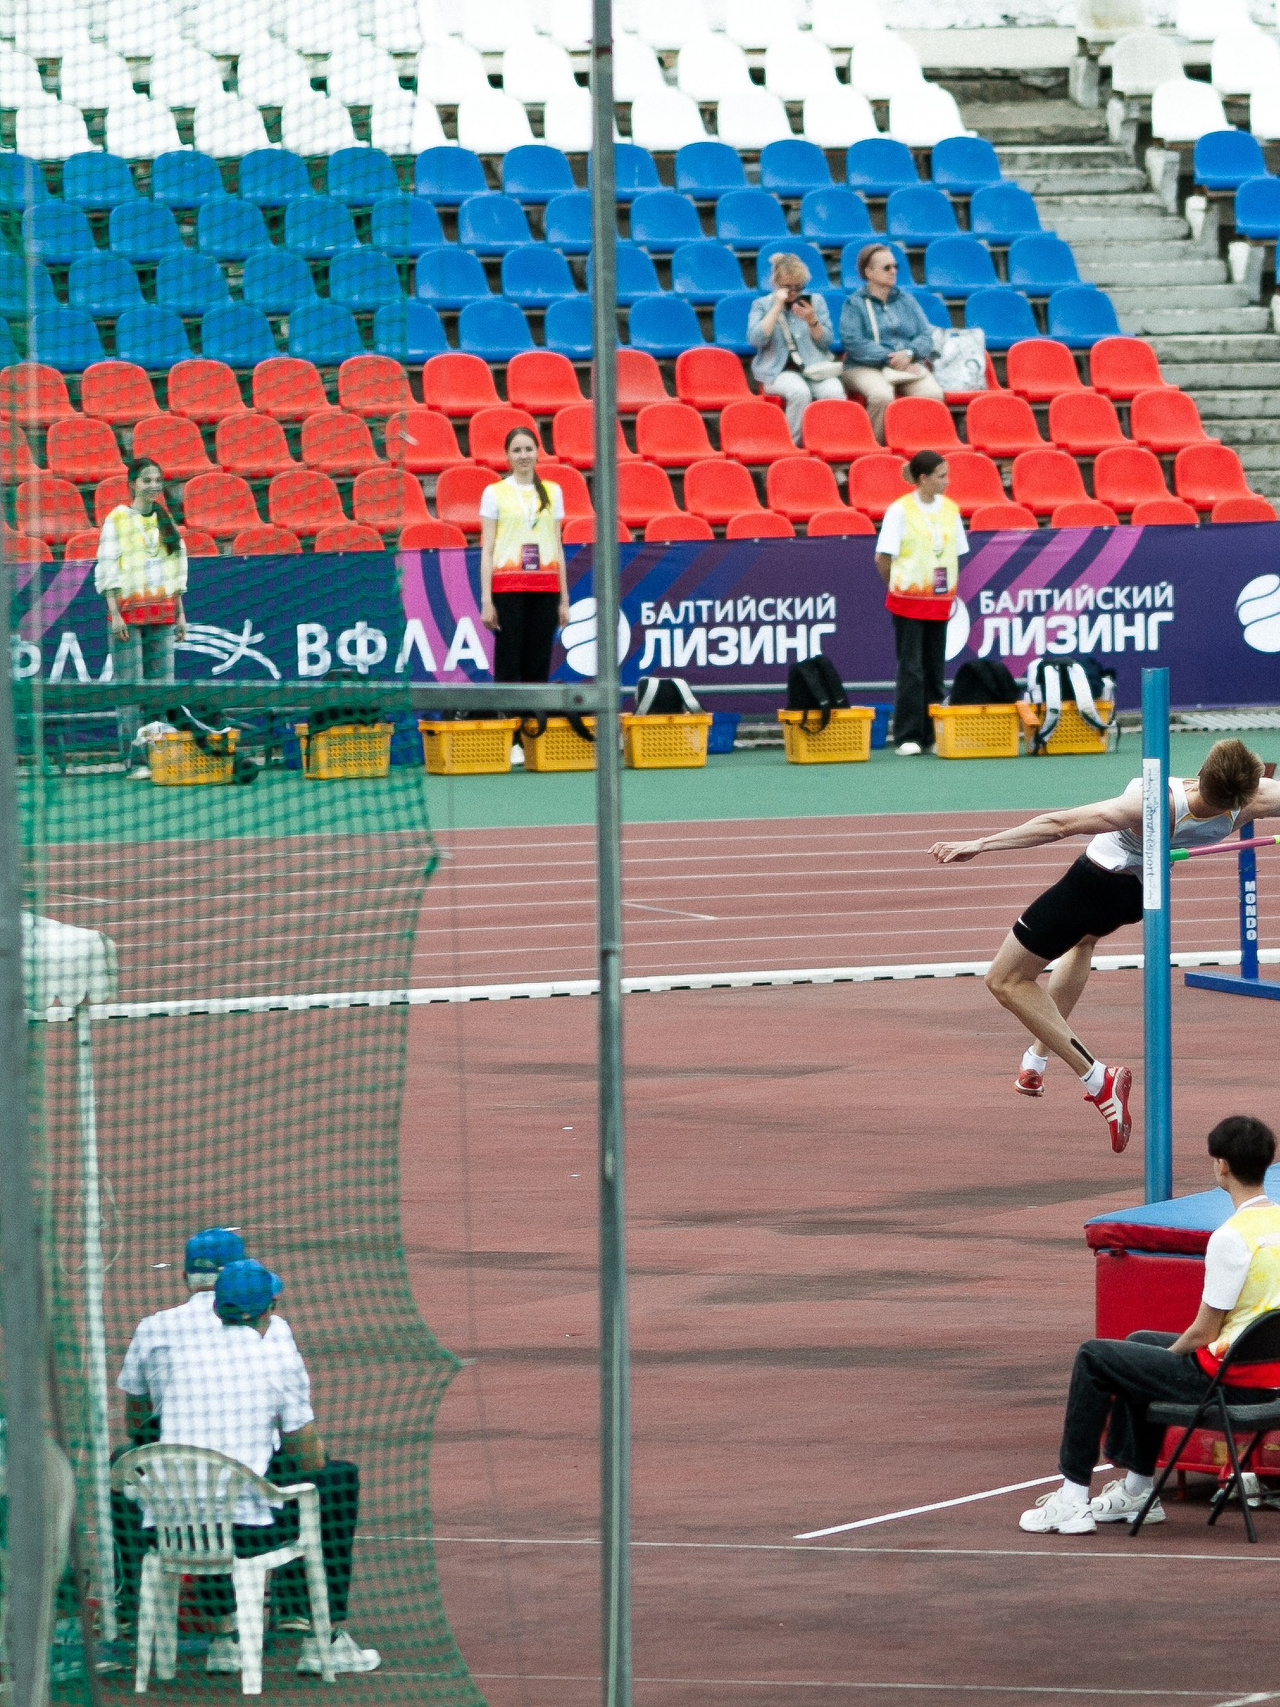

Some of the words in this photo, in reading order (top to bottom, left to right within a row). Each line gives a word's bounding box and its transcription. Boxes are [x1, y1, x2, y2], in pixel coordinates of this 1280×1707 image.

[640, 593, 836, 625] БАЛТИЙСКИЙ
[979, 581, 1174, 614] БАЛТИЙСКИЙ
[297, 617, 490, 676] ВФЛА
[639, 623, 836, 670] ЛИЗИНГ
[977, 612, 1174, 658] ЛИЗИНГ
[1245, 881, 1257, 940] MONDO
